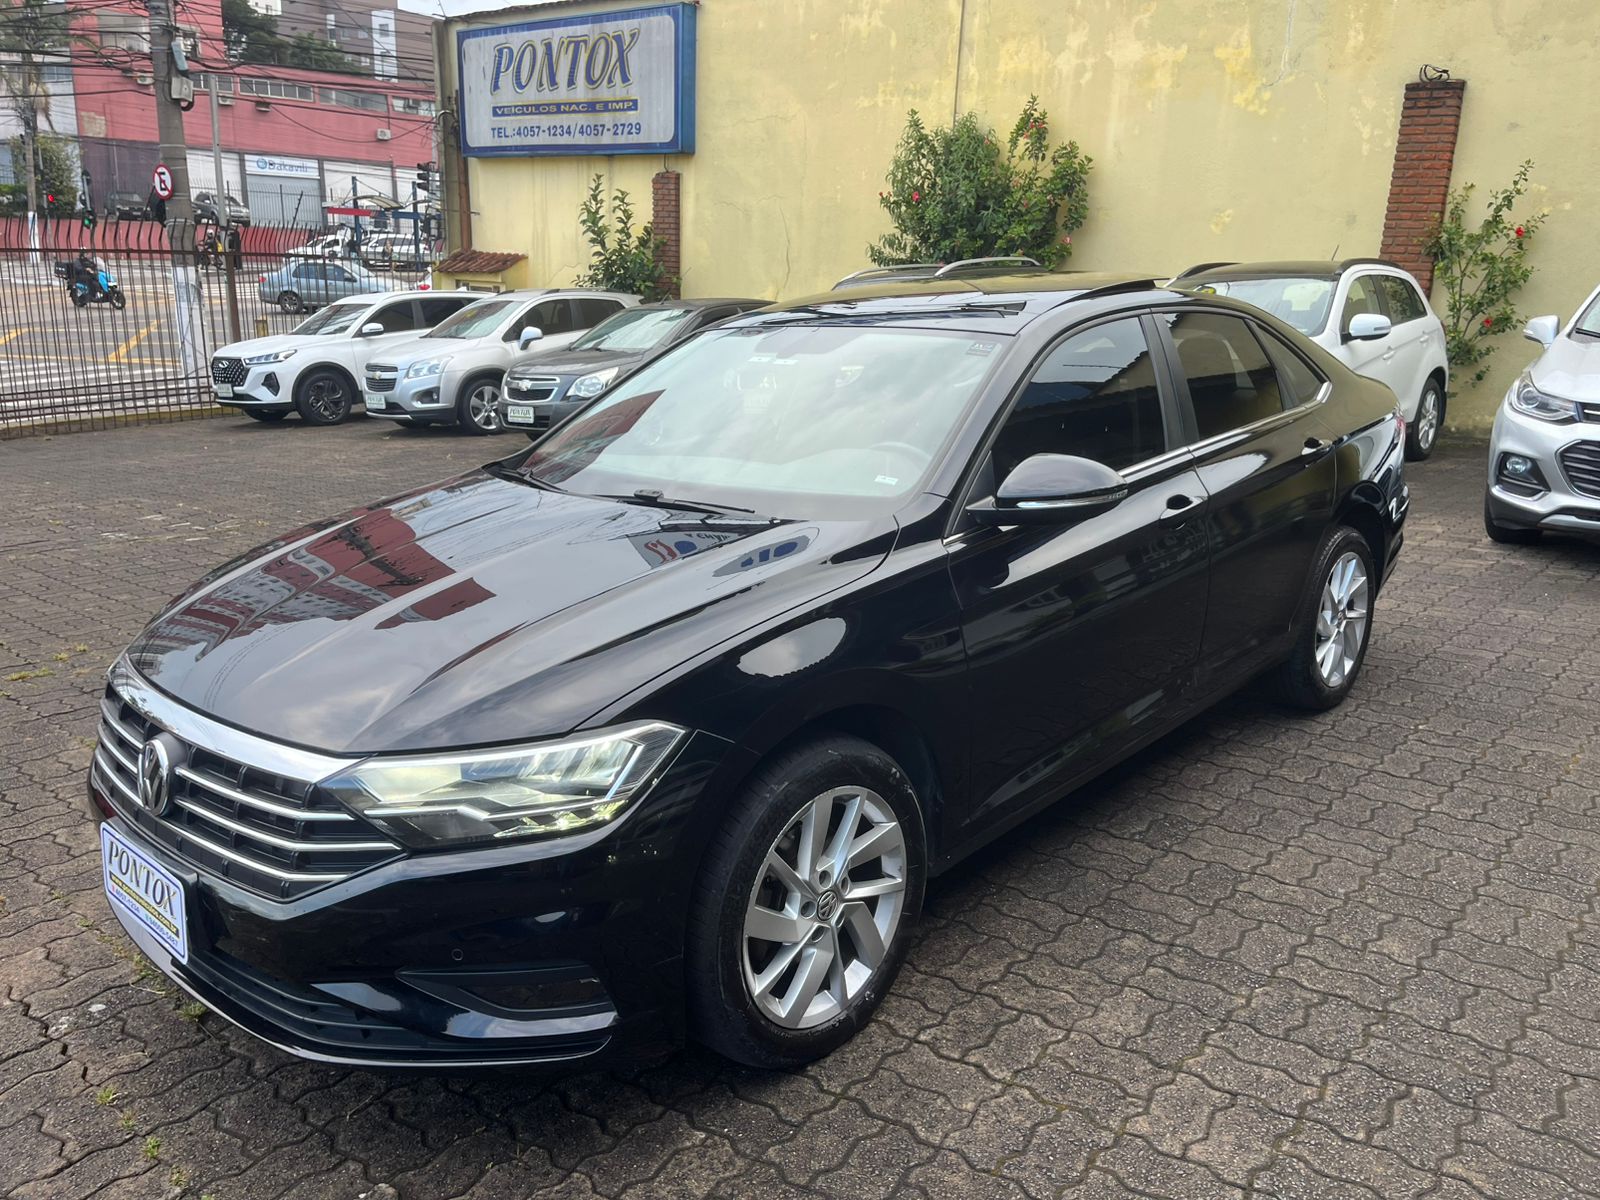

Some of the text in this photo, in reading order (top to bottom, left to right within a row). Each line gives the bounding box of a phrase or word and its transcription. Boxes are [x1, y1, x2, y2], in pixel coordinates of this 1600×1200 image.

[490, 28, 640, 96] PONTOX
[560, 103, 591, 113] NAC.
[596, 103, 605, 111] E
[608, 101, 636, 110] IMP.
[108, 838, 177, 919] PONTOX
